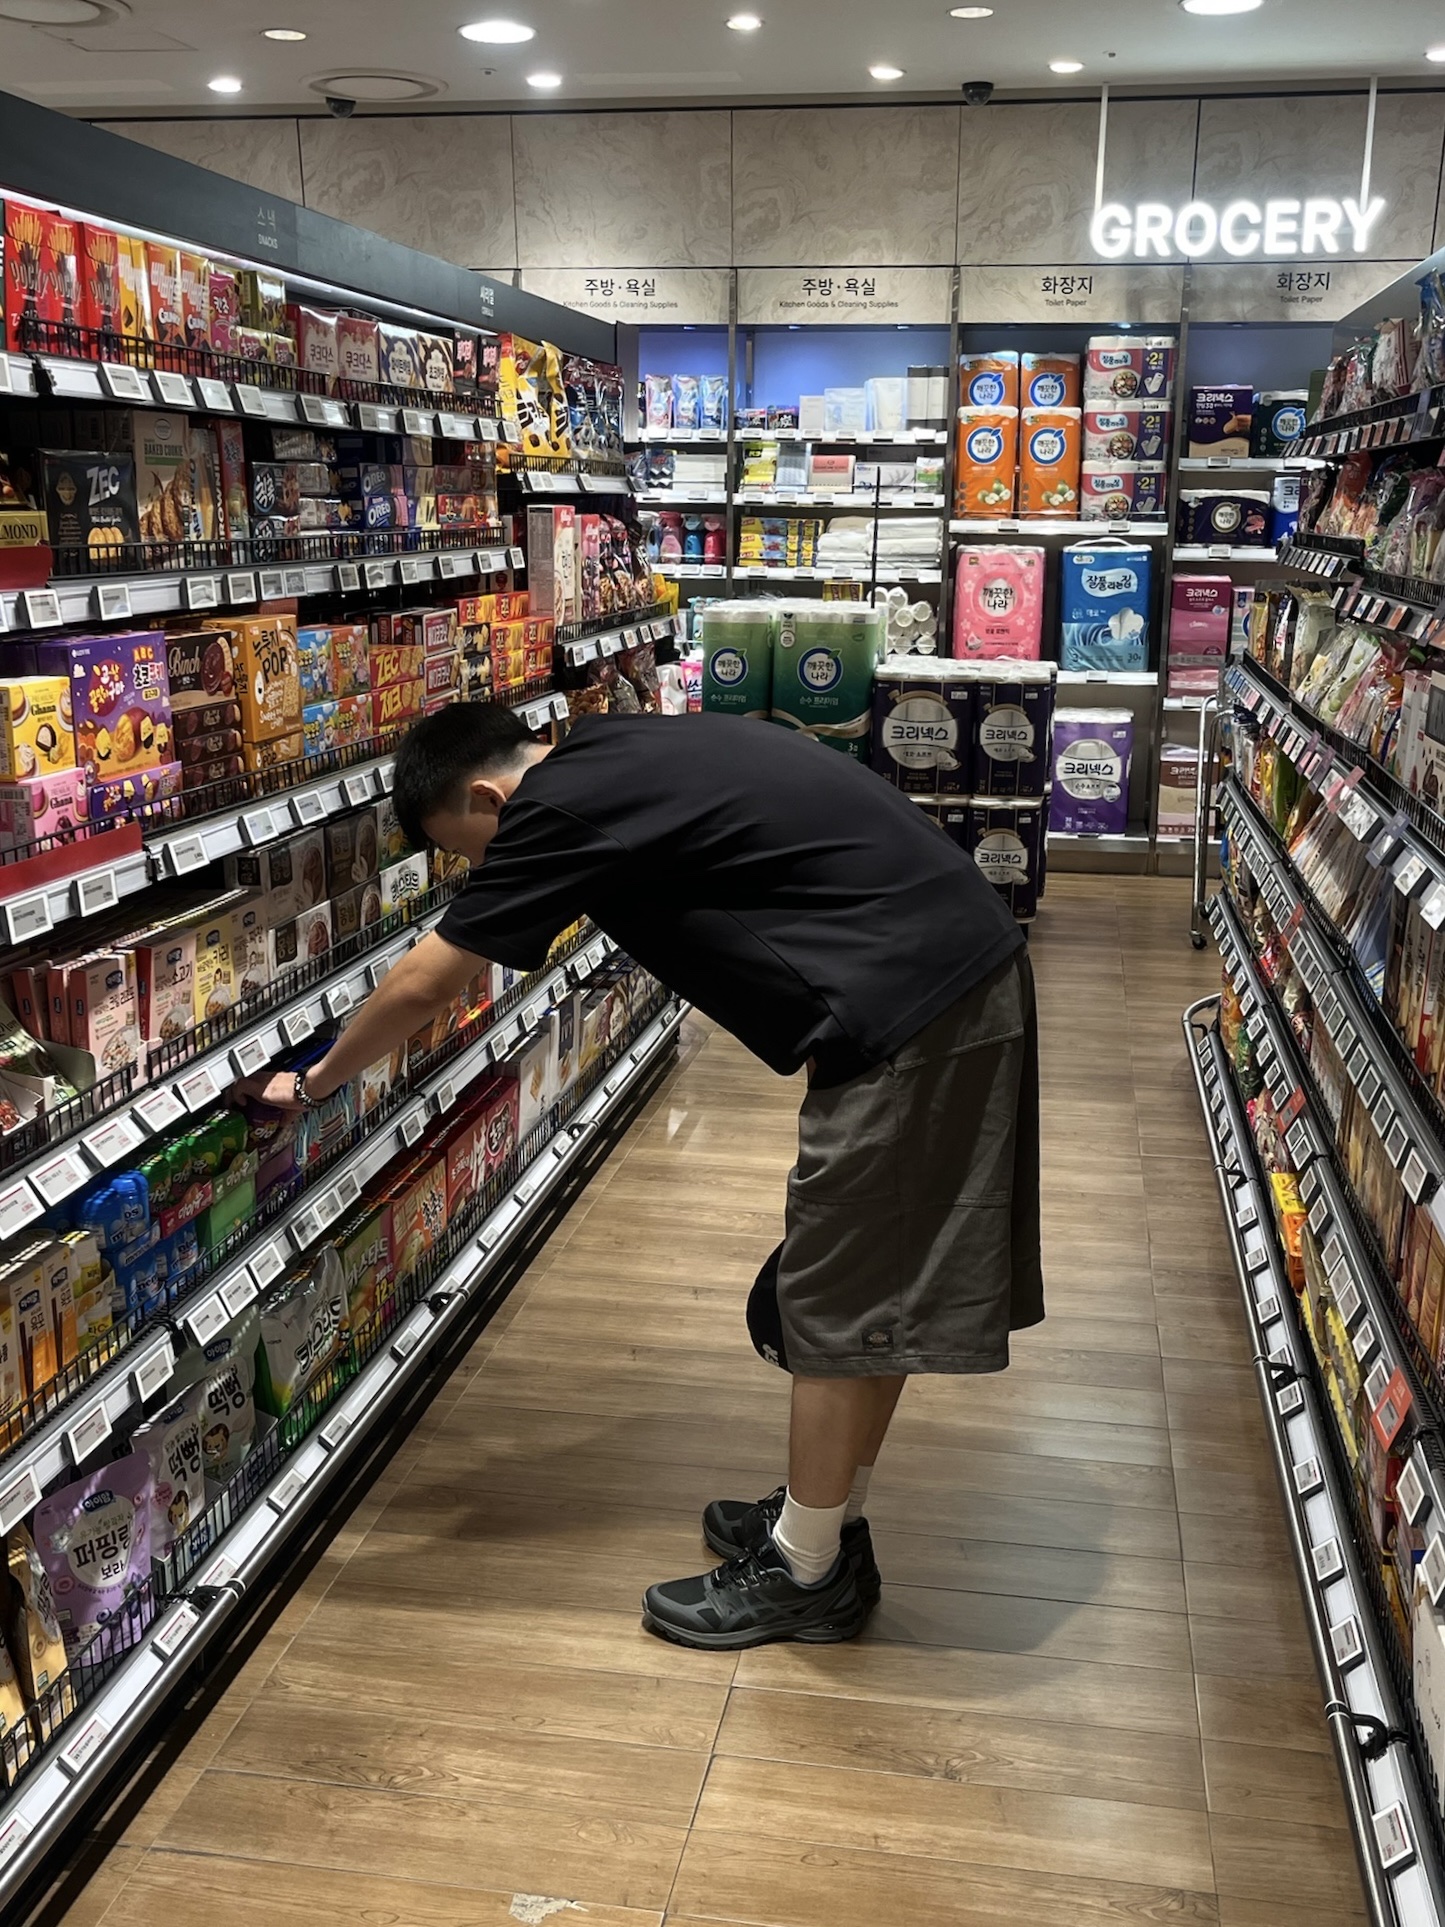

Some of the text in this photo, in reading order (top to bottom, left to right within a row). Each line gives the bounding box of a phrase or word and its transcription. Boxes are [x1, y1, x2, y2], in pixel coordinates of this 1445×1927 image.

[257, 207, 277, 232] 스낵
[1091, 197, 1387, 259] GROCERY
[258, 233, 279, 249] SNACKS
[584, 278, 656, 297] 주방·욕실
[801, 277, 876, 297] 주방·욕실
[1041, 274, 1094, 296] 화장지
[1275, 270, 1331, 293] 화장지
[562, 300, 588, 309] Kitchen
[589, 300, 611, 309] Goods
[619, 300, 648, 309] Cleaning
[649, 300, 678, 309] Supplies
[779, 300, 805, 309] Kitchen
[806, 300, 829, 309] Goods
[837, 300, 867, 309] Cleaning
[868, 300, 898, 309] Supplies
[1044, 297, 1087, 308] Toilet Paper
[1279, 294, 1323, 304] Toilet Paper
[309, 344, 335, 364] 쿠크다스
[345, 350, 373, 370] 쿠크다스
[1037, 383, 1058, 394] 깨끗한
[1040, 393, 1055, 401] 나라
[1196, 393, 1235, 403] 크리넥스
[144, 443, 184, 457] BAKED COOKIE
[1036, 437, 1059, 449] 깨끗한
[1039, 448, 1055, 457] 나라
[86, 466, 120, 507] ZEC
[363, 470, 386, 493] OREO
[368, 502, 391, 525] OREO
[983, 586, 1014, 601] 깨끗한
[1185, 588, 1219, 598] 크리넥스
[987, 599, 1009, 611] 나라
[133, 645, 154, 662] ABC
[168, 645, 200, 678] Binch
[262, 646, 287, 684] POP
[376, 649, 400, 688] ZEC
[717, 659, 740, 670] 깨끗한
[806, 659, 834, 671] 깨끗한
[721, 669, 736, 677] 나라
[811, 670, 829, 682] 나라
[31, 703, 57, 717] Ghana
[890, 725, 949, 742] 크리넥스
[984, 729, 1029, 742] 크리넥스
[1063, 762, 1114, 776] 크리넥스
[50, 796, 74, 810] Ghana
[979, 852, 1023, 865] 크리넥스
[346, 1236, 389, 1289] 카스타드
[100, 1560, 125, 1581] 보라
